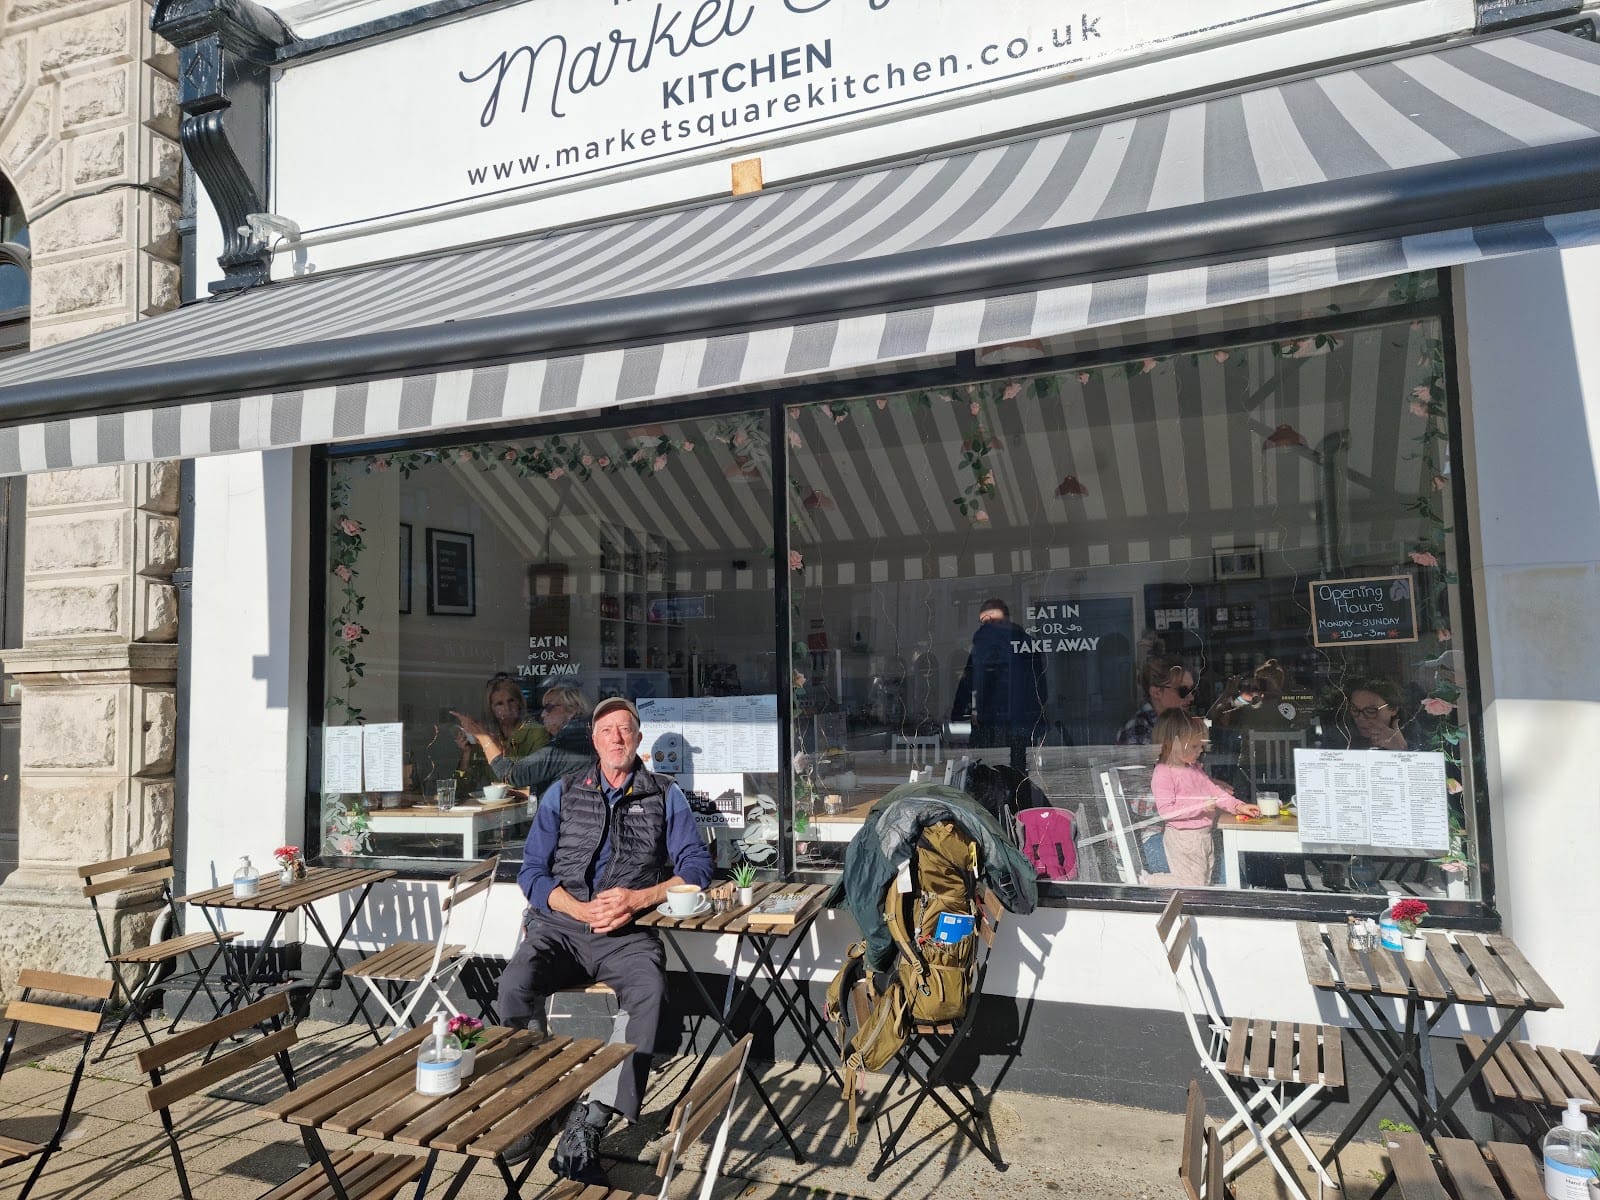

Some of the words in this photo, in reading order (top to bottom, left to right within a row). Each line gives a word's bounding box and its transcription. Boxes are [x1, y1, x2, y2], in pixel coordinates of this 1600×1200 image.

[662, 38, 832, 109] KITCHEN
[467, 13, 1101, 186] www.marketsquarekitchen.co.uk
[1320, 585, 1383, 605] Opening
[1026, 606, 1057, 619] EAT
[1062, 604, 1079, 618] IN
[1337, 600, 1384, 613] Hours
[1042, 623, 1068, 635] OR
[529, 636, 552, 648] EAT
[554, 635, 568, 647] IN
[1010, 639, 1052, 653] TAKE
[1056, 637, 1099, 652] AWAY
[540, 650, 559, 661] OR
[517, 664, 547, 677] TAKE
[549, 663, 579, 676] AWAY
[695, 815, 741, 823] oveDover
